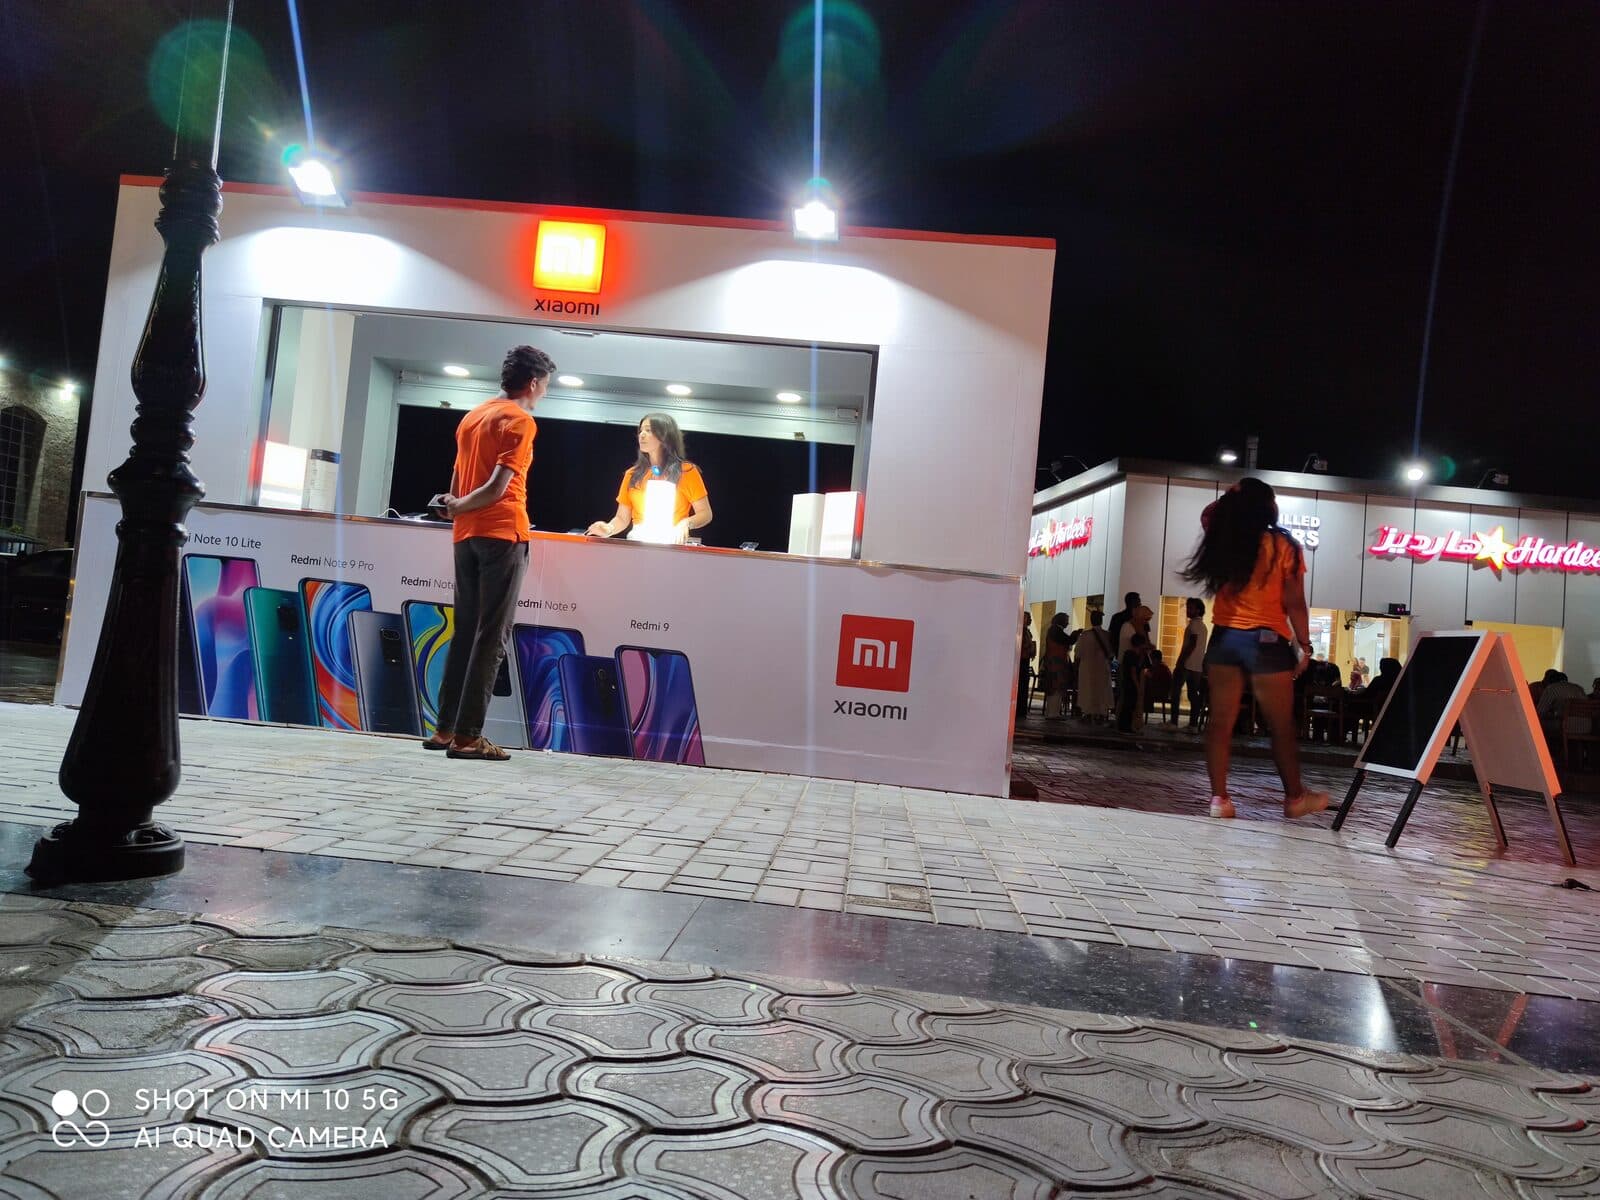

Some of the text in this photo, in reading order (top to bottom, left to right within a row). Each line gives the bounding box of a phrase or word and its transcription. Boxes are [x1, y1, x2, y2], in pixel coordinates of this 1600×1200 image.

[1279, 512, 1320, 528] ILLED
[194, 533, 221, 545] Note
[225, 535, 238, 547] 10
[241, 537, 262, 549] Lite
[291, 554, 374, 571] Redmi Note 9 Pro
[401, 576, 431, 587] Redmi
[514, 599, 577, 612] edmi Note 9
[630, 619, 670, 632] Redmi 9
[833, 700, 907, 720] xiaomi
